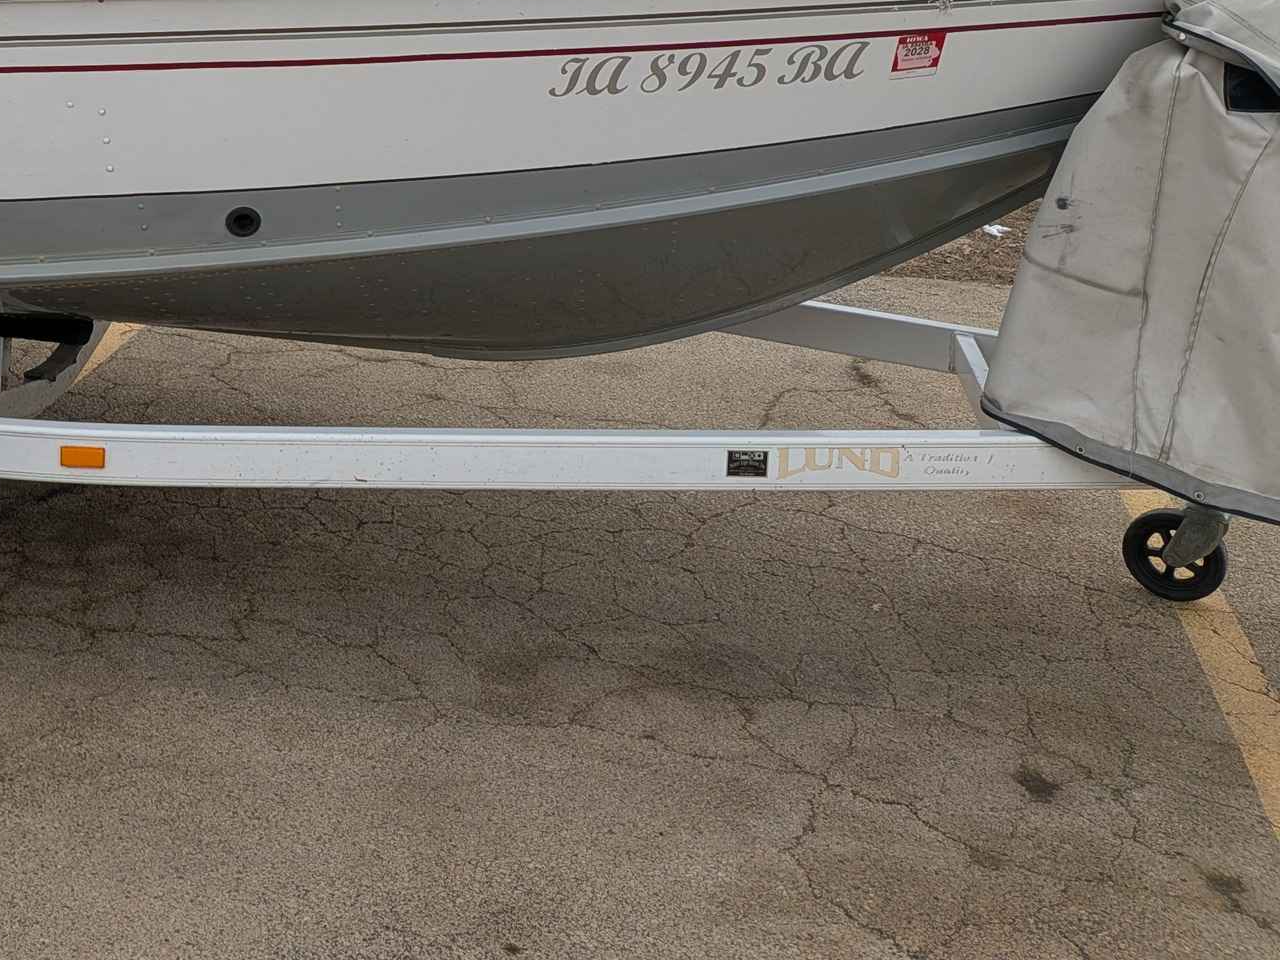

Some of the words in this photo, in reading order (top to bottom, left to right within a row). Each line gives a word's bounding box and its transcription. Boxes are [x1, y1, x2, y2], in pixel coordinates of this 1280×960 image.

[903, 46, 931, 57] 2028
[639, 47, 774, 94] 8945
[776, 40, 871, 86] BA
[776, 447, 901, 480] LUND
[924, 465, 971, 478] Quality
